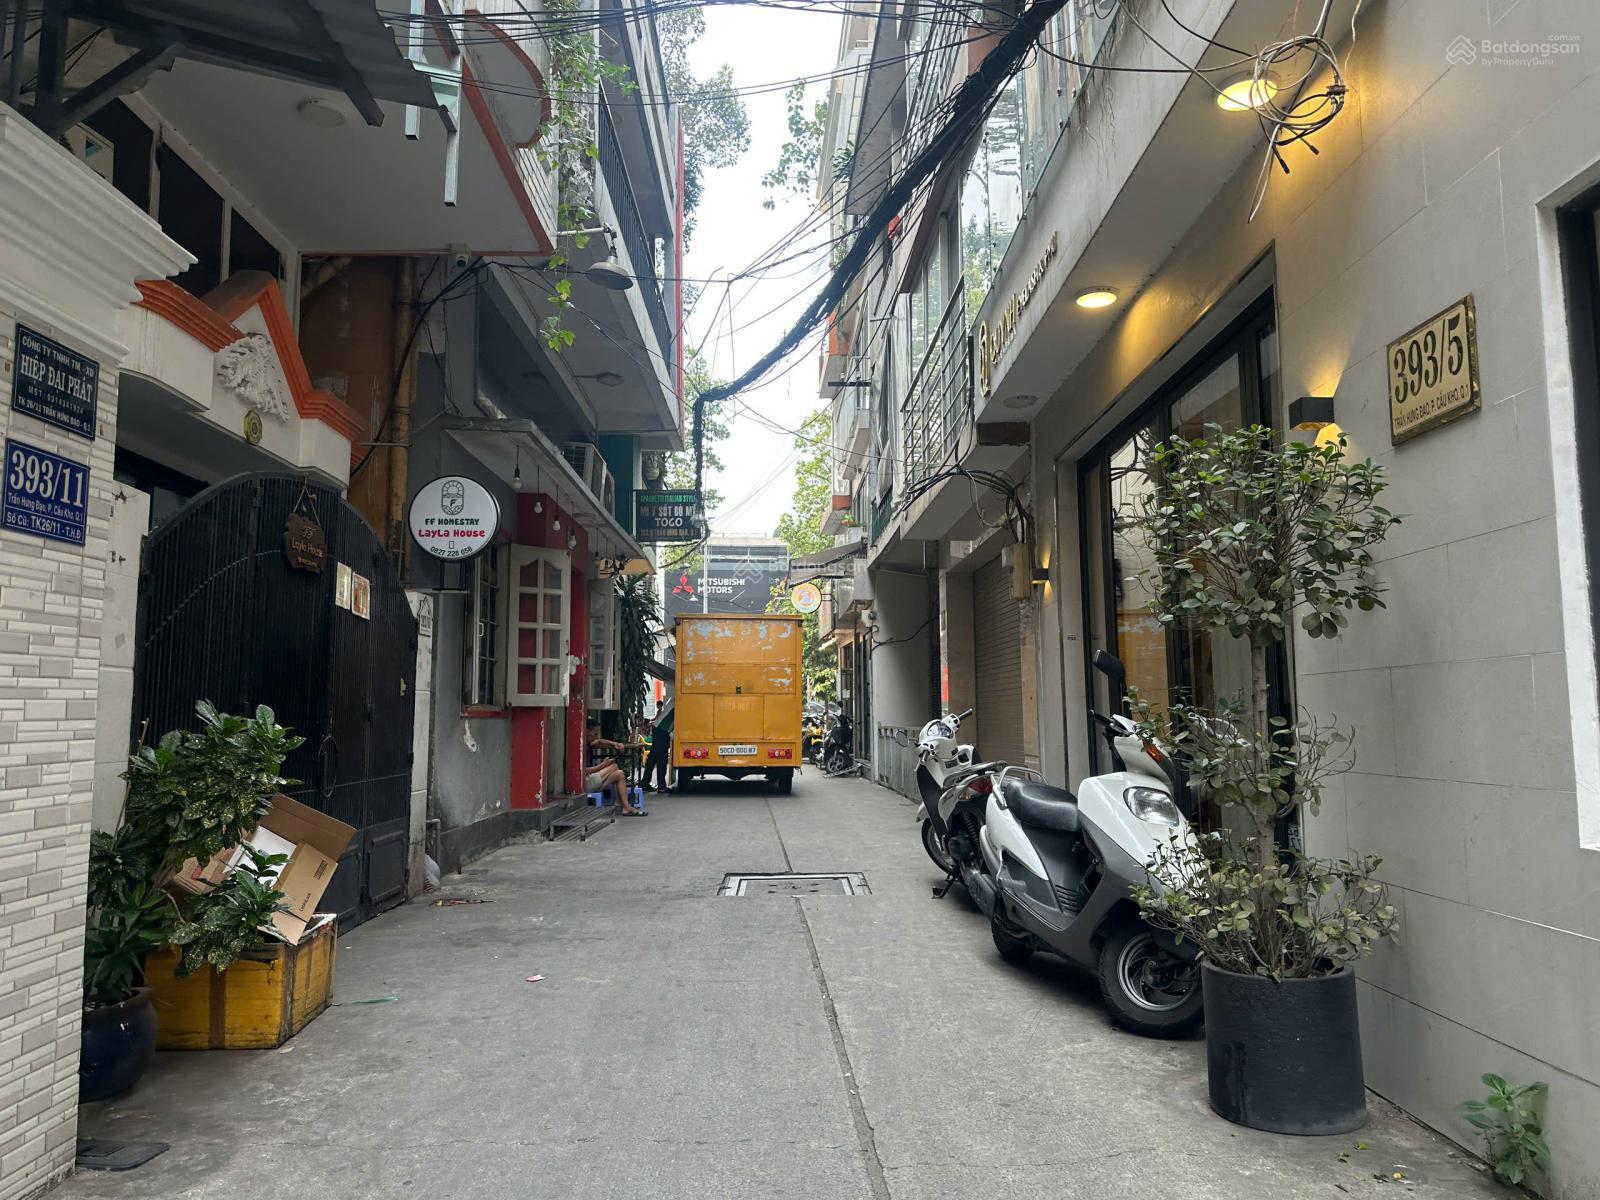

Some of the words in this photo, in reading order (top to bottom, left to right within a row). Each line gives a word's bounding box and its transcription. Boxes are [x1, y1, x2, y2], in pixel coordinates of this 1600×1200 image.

[22, 335, 41, 353] CÔNG
[42, 345, 51, 357] TY
[53, 350, 70, 367] TNHH
[71, 359, 80, 372] TM
[1393, 312, 1464, 404] 393/5
[20, 354, 46, 385] HIỆP
[47, 365, 66, 394] ĐẠI
[67, 375, 93, 403] PHÁT
[10, 450, 83, 508] 393/11
[7, 511, 16, 523] Số
[31, 515, 60, 535] TK26/11
[424, 518, 436, 526] FF
[438, 518, 480, 526] HOMESTAY
[655, 517, 683, 527] TOGO
[453, 529, 486, 538] House
[697, 578, 746, 586] MTSUBISHI
[697, 586, 733, 594] MOTORS
